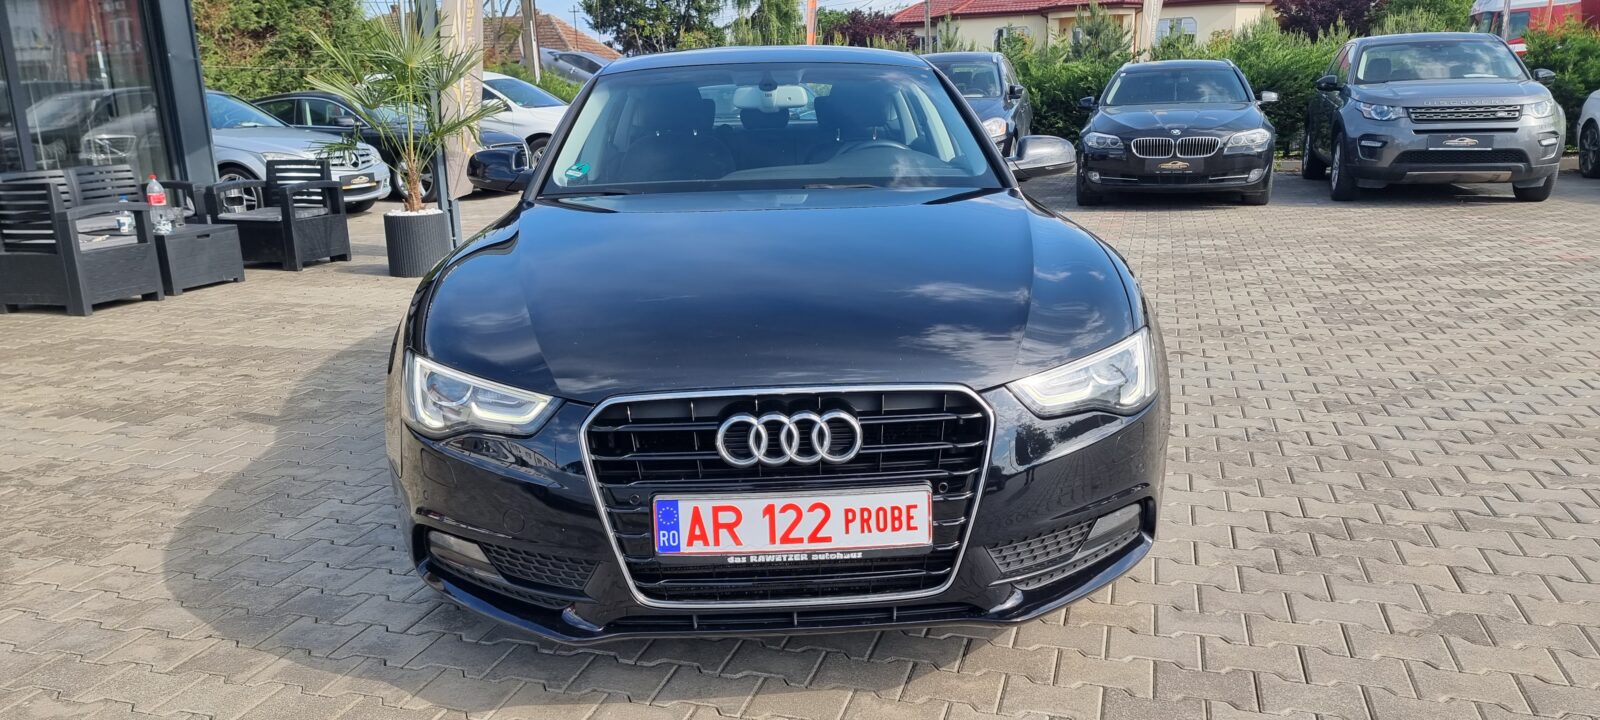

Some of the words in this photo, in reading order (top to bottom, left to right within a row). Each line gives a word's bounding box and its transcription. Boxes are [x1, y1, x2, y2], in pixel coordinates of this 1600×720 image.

[686, 505, 744, 548] AR
[762, 501, 833, 546] 122
[844, 504, 919, 535] PROBE
[660, 530, 679, 547] RO
[726, 556, 746, 564] das
[811, 551, 863, 560] autohaus
